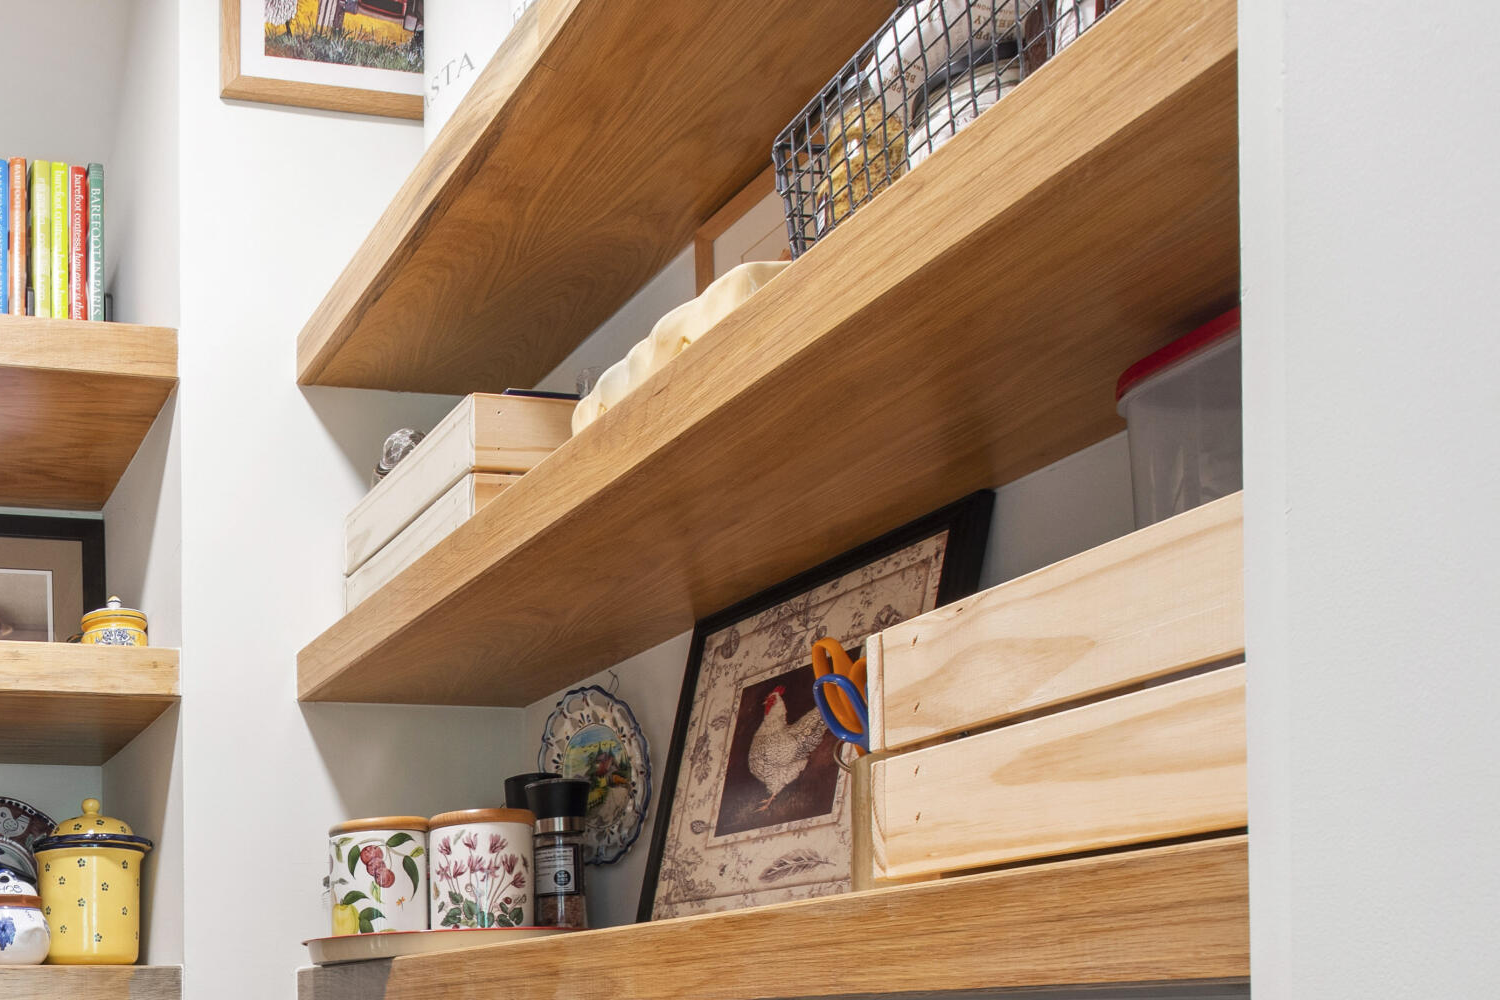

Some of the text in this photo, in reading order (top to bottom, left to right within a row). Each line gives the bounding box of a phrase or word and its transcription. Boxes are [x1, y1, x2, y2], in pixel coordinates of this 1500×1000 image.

[75, 174, 83, 211] barefoot
[91, 188, 101, 315] BAREFOOT IN PARIS
